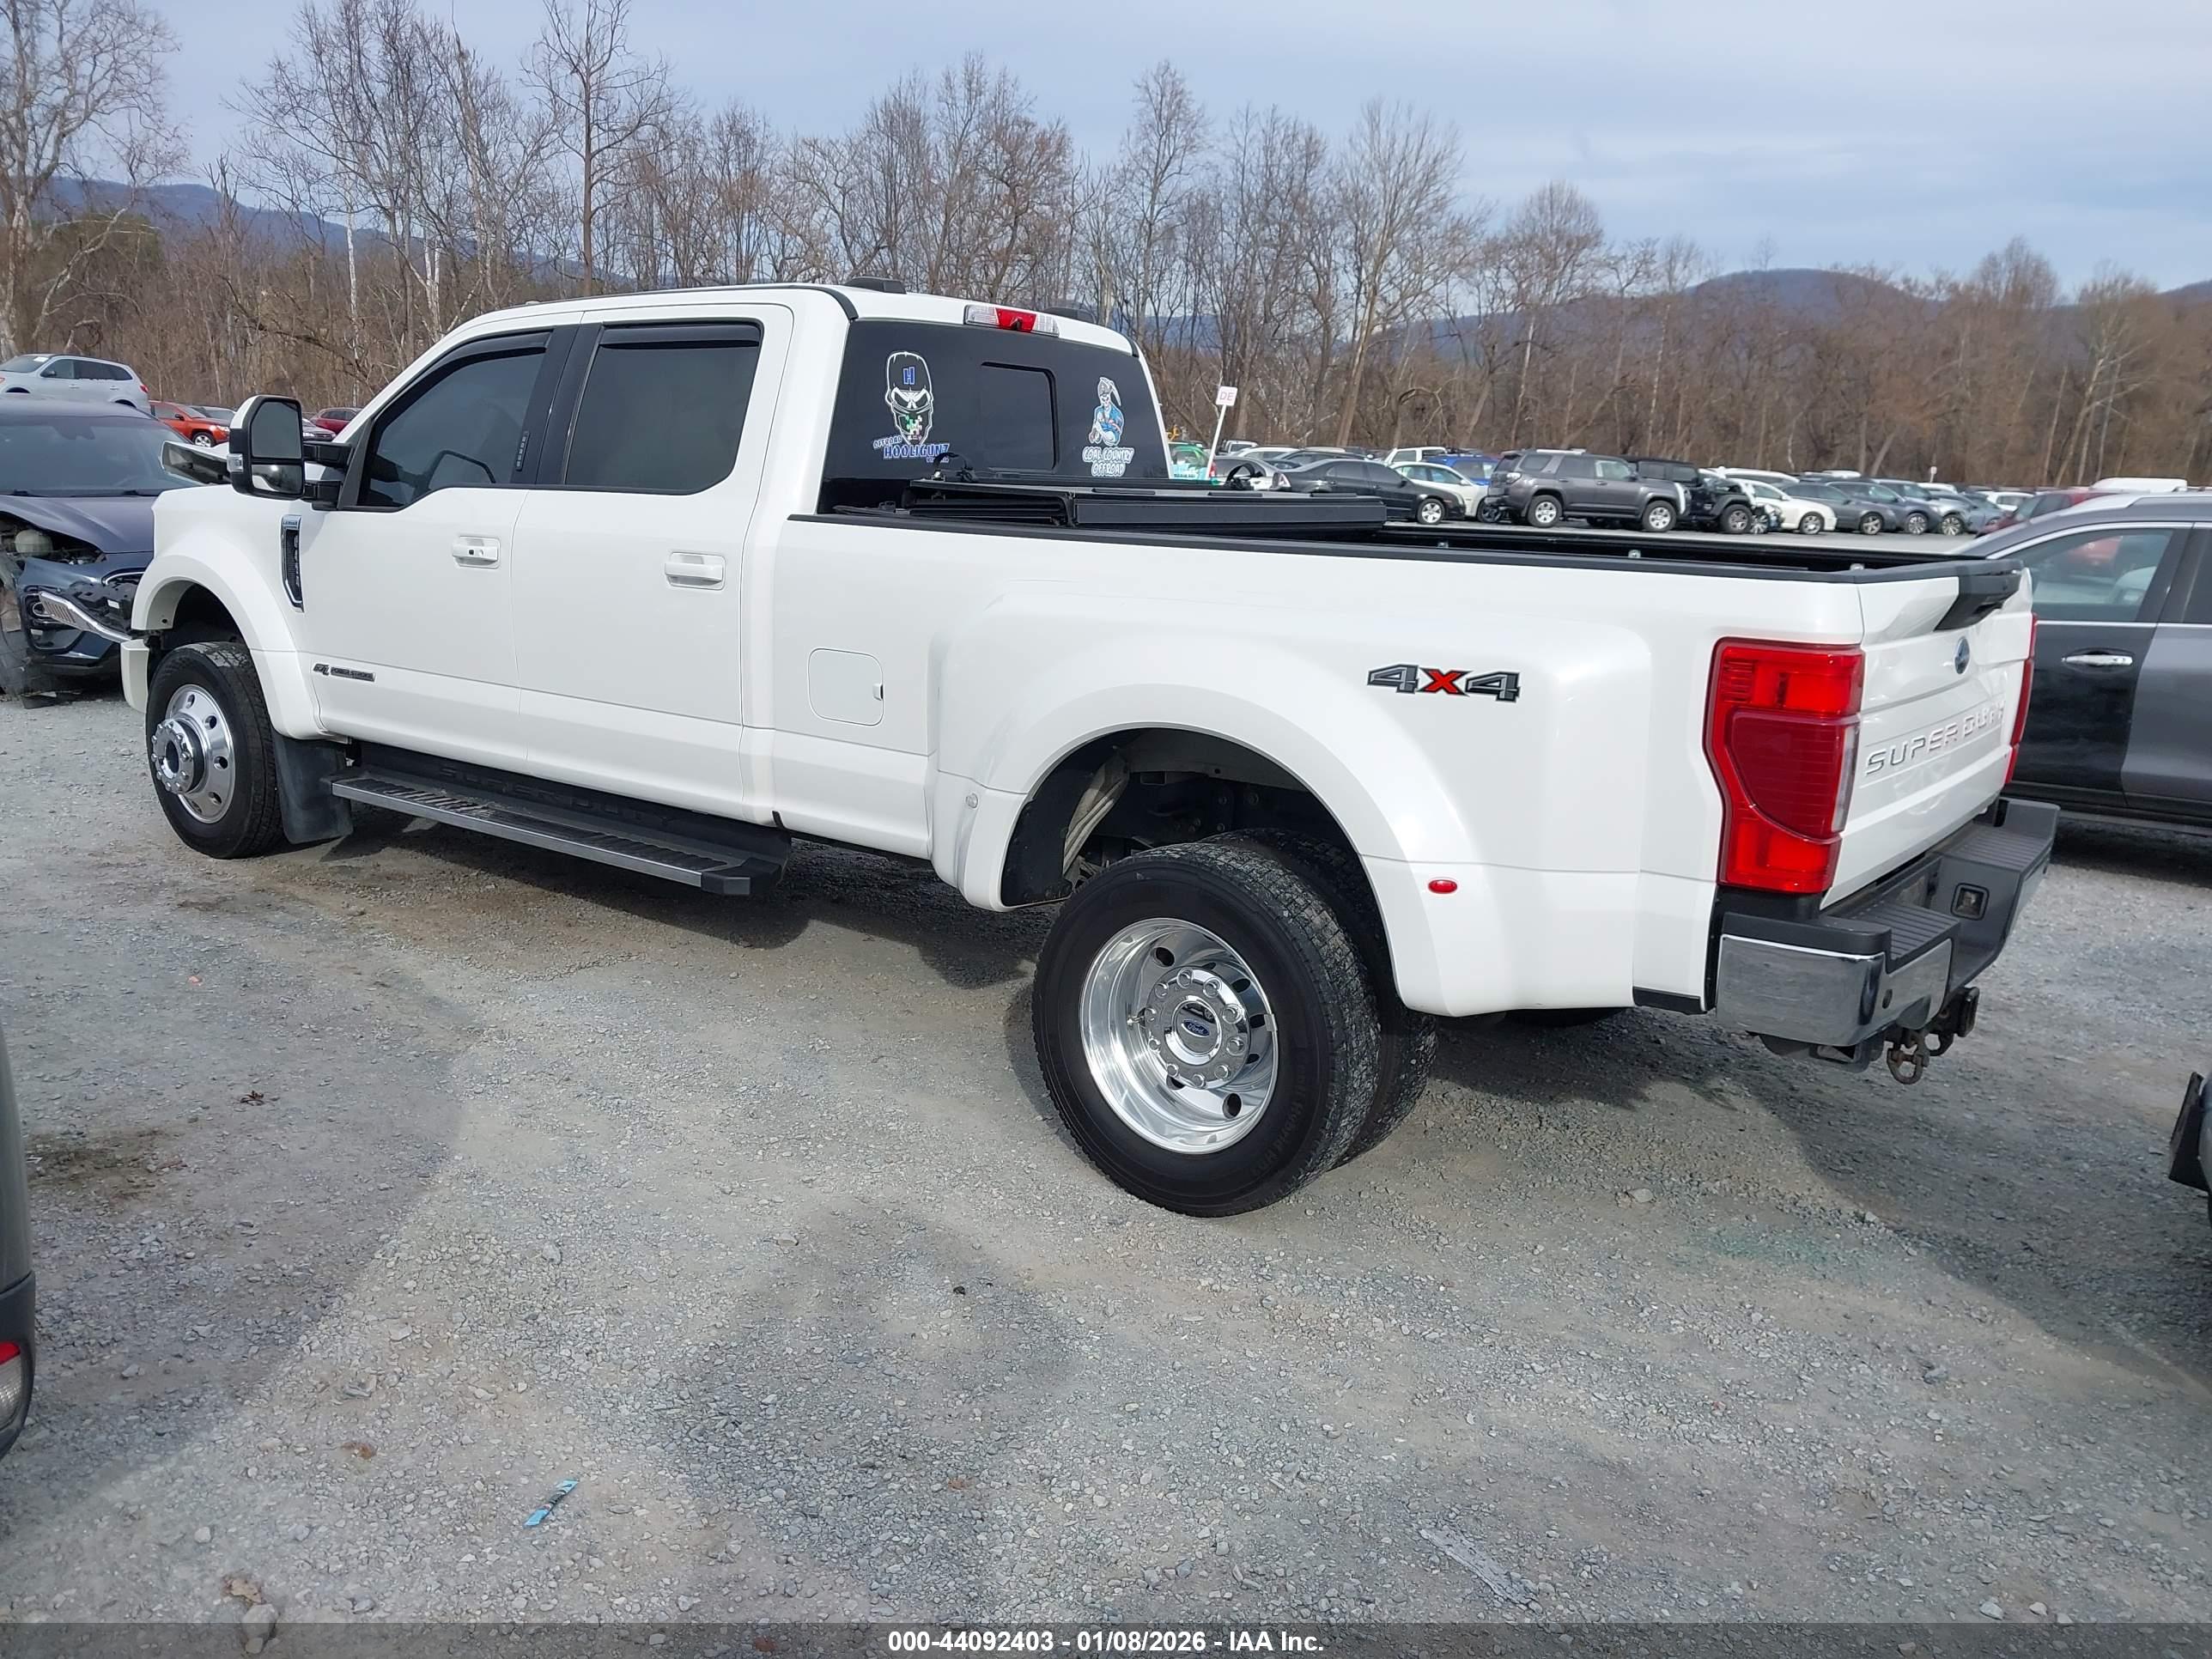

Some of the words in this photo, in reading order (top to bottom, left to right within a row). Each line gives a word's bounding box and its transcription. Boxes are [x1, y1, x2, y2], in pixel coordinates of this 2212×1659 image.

[902, 366, 915, 386] H
[1219, 391, 1235, 401] DE
[1084, 447, 1102, 463] COAL
[1103, 447, 1135, 464] COUNTRY
[1091, 462, 1127, 477] OFFROAD
[1865, 723, 1959, 775] SUPER
[1963, 700, 2005, 738] DUTY
[1187, 1023, 1206, 1035] Ford
